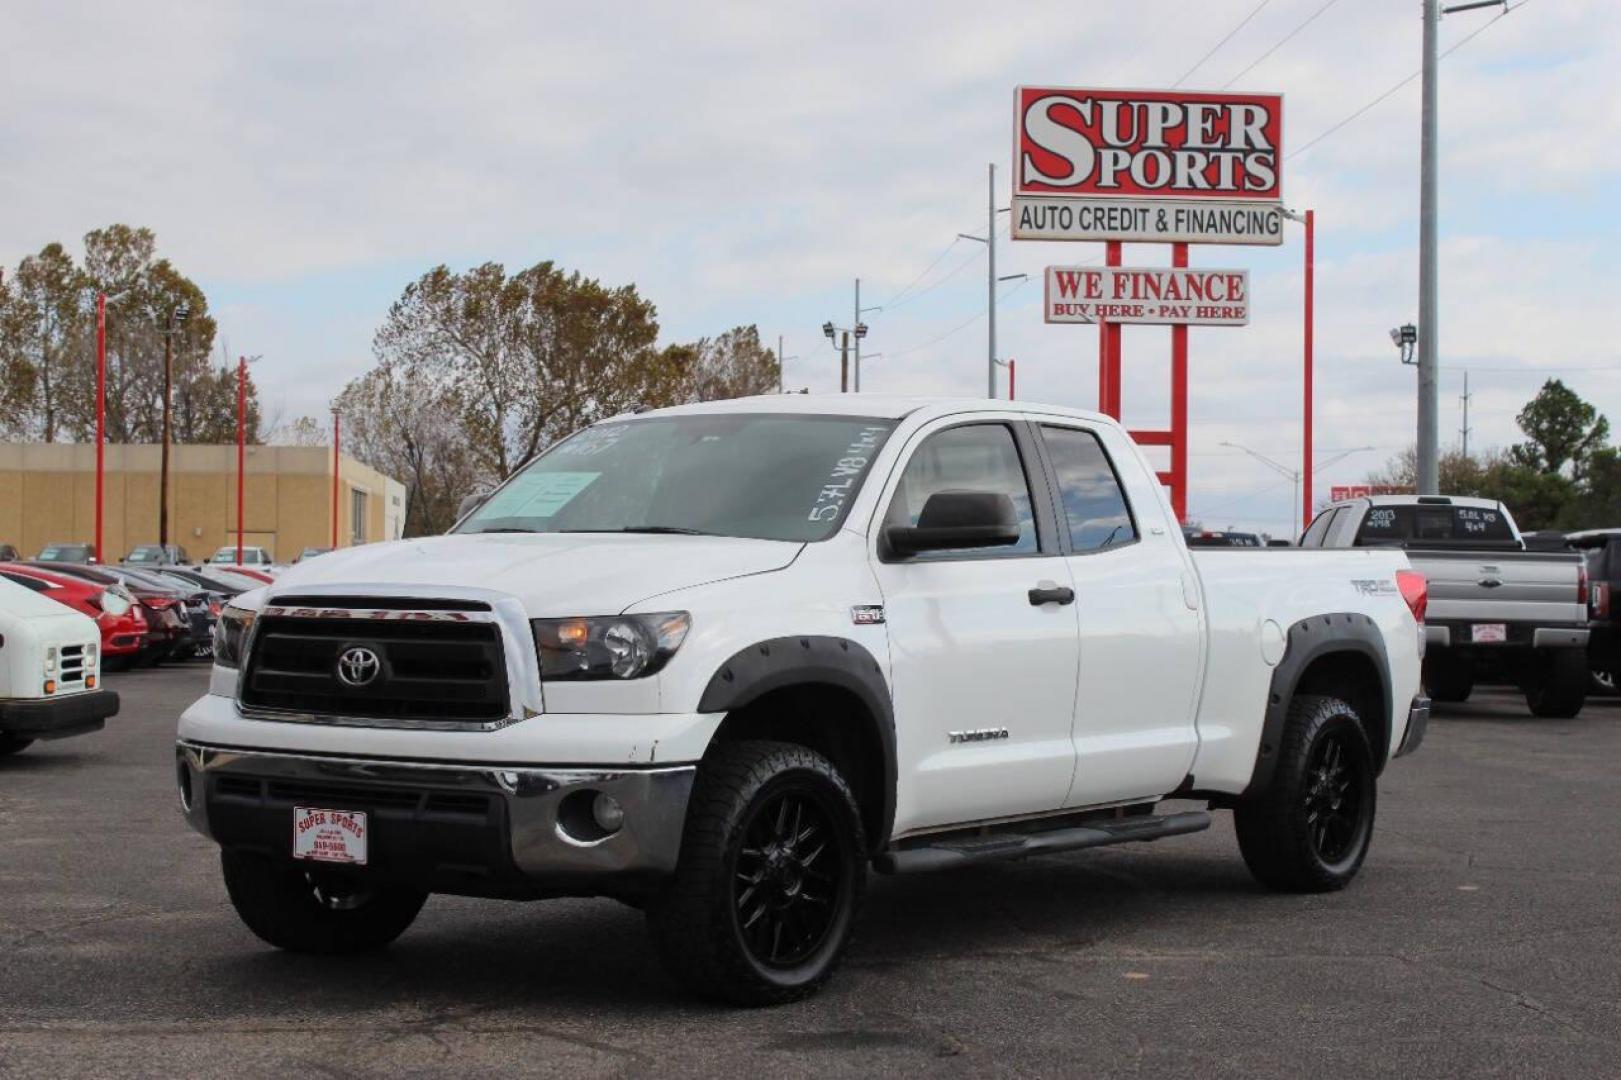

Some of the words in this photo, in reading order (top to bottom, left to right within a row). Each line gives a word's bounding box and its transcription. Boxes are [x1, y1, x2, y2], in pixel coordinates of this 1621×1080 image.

[1019, 205, 1073, 230] AUTO
[1079, 207, 1150, 232] CREDIT
[1155, 209, 1169, 233] &
[1175, 209, 1280, 235] FINANCING
[1055, 271, 1103, 300] WE
[1111, 272, 1245, 302] FINANCE
[1053, 304, 1091, 317] BUY
[1095, 305, 1144, 318] HERE
[1159, 306, 1192, 318] PAY
[1196, 306, 1246, 319] HERE
